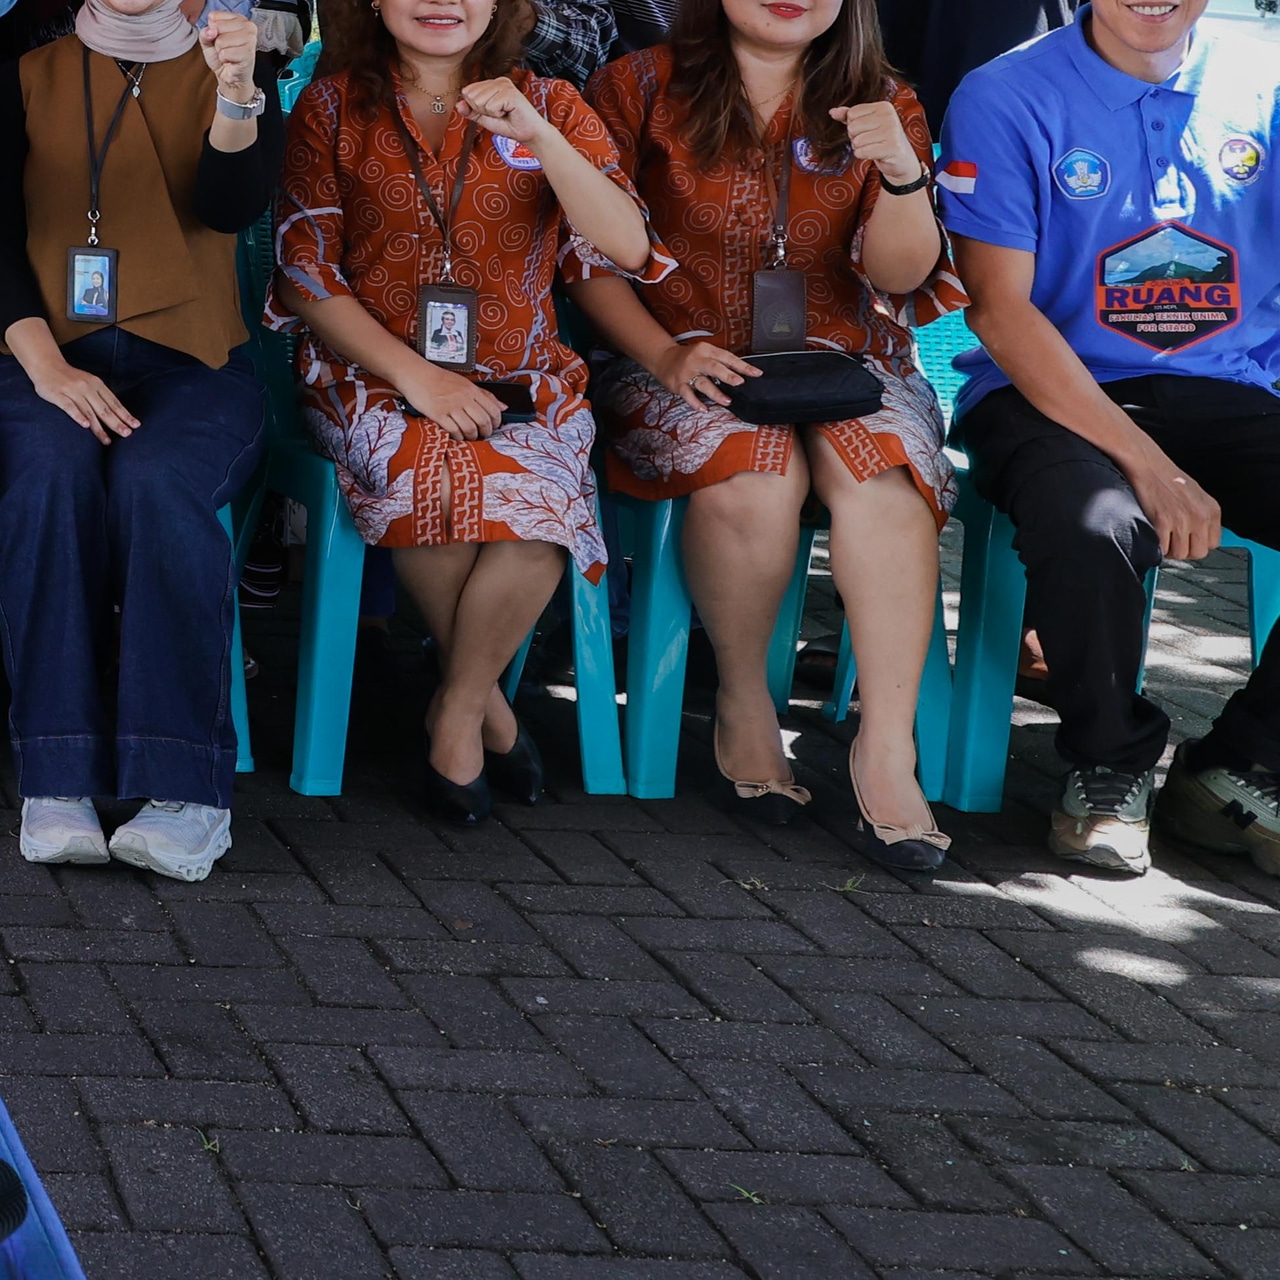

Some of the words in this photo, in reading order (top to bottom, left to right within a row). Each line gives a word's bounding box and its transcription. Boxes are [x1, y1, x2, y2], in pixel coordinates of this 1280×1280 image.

[1105, 285, 1231, 308] RUANG
[1109, 313, 1154, 322] FAKULTAS
[1155, 312, 1191, 320] TEKNIK
[1192, 312, 1227, 320] UNIMA
[1137, 323, 1157, 332] FOR
[1158, 323, 1196, 332] SITARO
